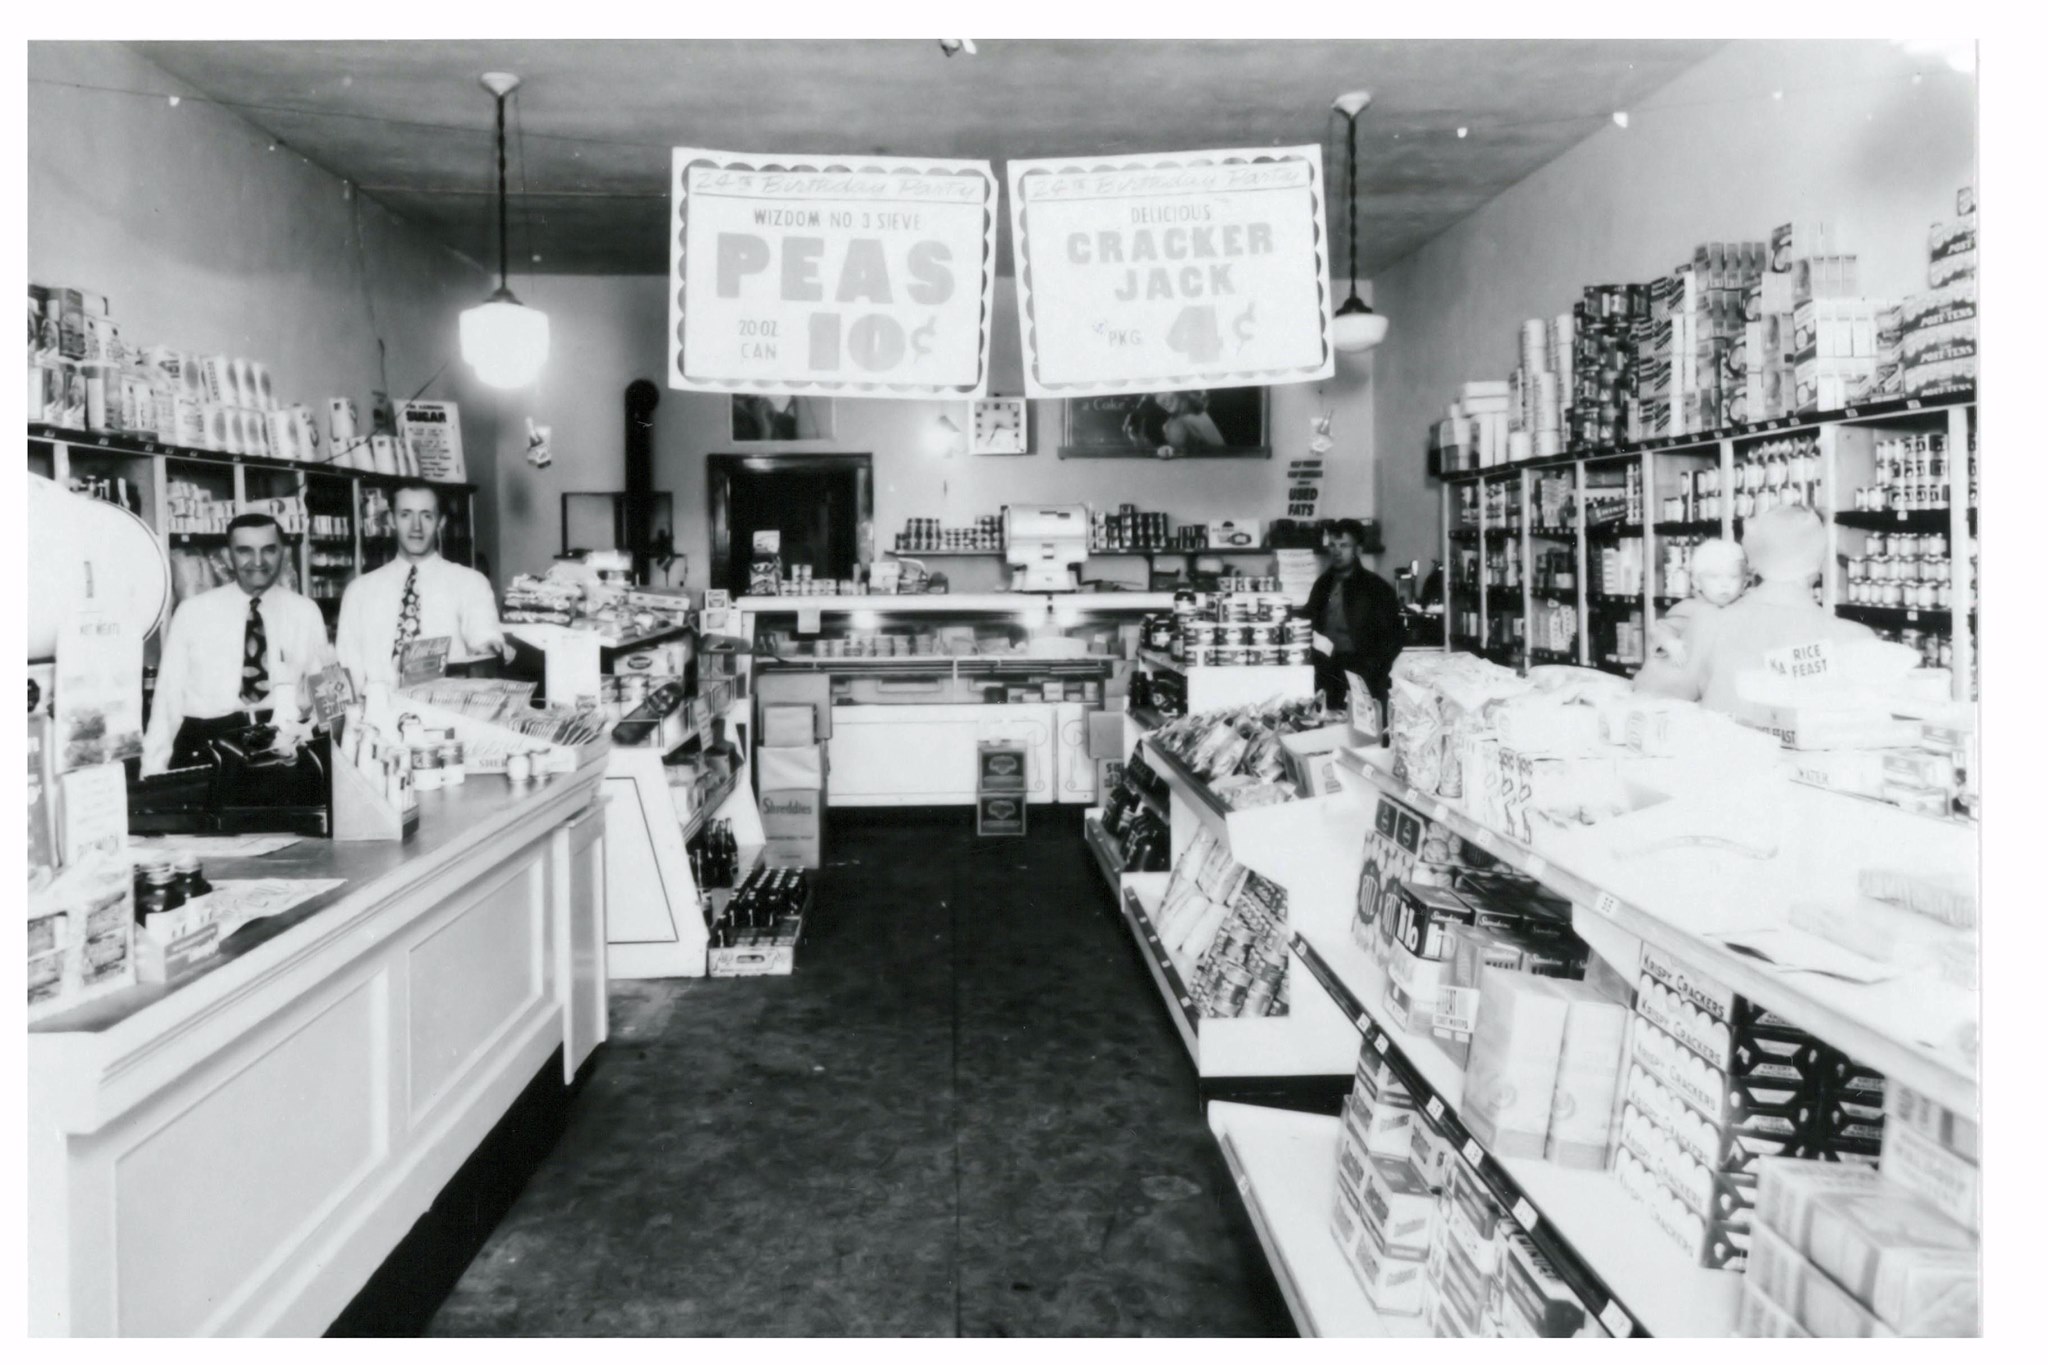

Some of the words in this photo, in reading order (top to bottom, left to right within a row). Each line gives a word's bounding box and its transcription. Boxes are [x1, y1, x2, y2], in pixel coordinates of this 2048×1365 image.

[762, 172, 886, 195] Birthday
[899, 179, 977, 198] Party
[1096, 173, 1216, 193] Birthday
[1228, 166, 1300, 186] Party
[753, 207, 821, 228] WIZDOM
[861, 212, 871, 227] 3
[876, 212, 921, 231] SIEVE
[1131, 203, 1213, 224] DELICIOUS
[1066, 221, 1274, 265] CRACKER
[714, 231, 956, 306] PEAS
[1113, 264, 1237, 301] JACK
[1107, 327, 1143, 347] PKG
[739, 341, 778, 361] CAN
[406, 410, 447, 423] SUGAR
[1288, 487, 1319, 501] USED
[1287, 503, 1315, 517] FATS
[1793, 644, 1822, 662] RICE
[1791, 658, 1829, 678] FEAST
[762, 796, 813, 815] Shreddies
[1643, 954, 1673, 981] KRISPY
[1676, 974, 1725, 1019] CRACKERS
[1641, 999, 1669, 1025] KRISPY
[1673, 1020, 1722, 1066] CRACKERS
[1669, 1064, 1717, 1111] CRACKERS
